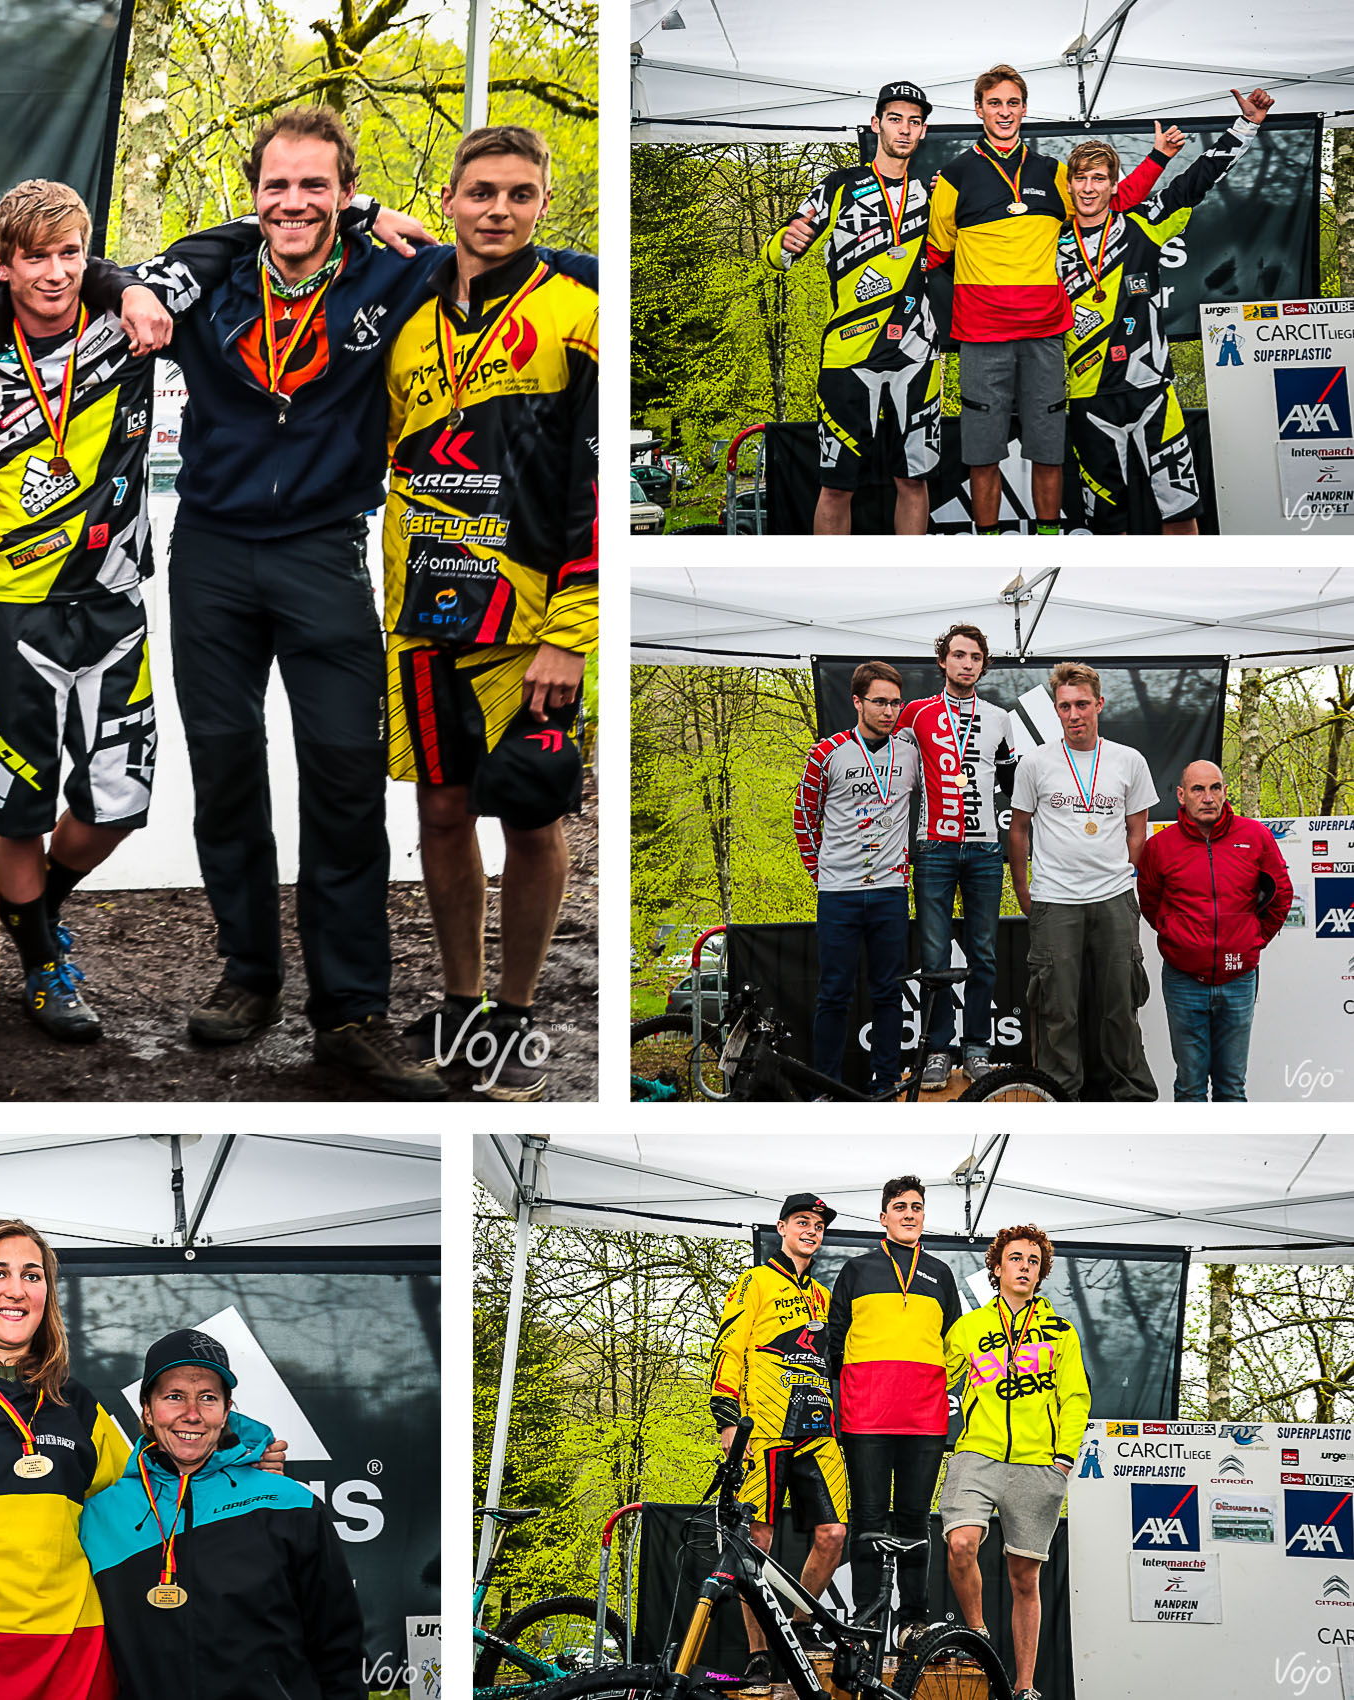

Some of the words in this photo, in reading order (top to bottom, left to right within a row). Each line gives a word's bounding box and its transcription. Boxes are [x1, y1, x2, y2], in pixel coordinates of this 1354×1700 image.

[889, 85, 922, 100] YETI
[854, 277, 890, 297] adidas
[1129, 278, 1147, 289] ice
[1204, 305, 1231, 316] urge
[1308, 301, 1354, 315] NOTUBE
[1074, 311, 1100, 335] adidas
[1256, 323, 1329, 342] CARCIT
[1253, 347, 1332, 363] SUPERPLASTIC
[153, 389, 187, 398] CITR
[1279, 403, 1340, 432] AXA
[1291, 447, 1354, 460] Intermarch
[407, 473, 503, 489] KROSS
[20, 472, 74, 508] adidas
[1306, 490, 1354, 501] NANDRIN
[408, 514, 508, 541] Bicyclic
[429, 555, 500, 573] omnimut
[1308, 820, 1354, 832] SUPERPLA
[1333, 863, 1354, 873] NOT
[1316, 907, 1354, 932] AX
[978, 1328, 1044, 1353] eleen
[1166, 1424, 1215, 1435] NOTUBES
[1218, 1425, 1263, 1439] FOX
[1277, 1426, 1352, 1441] SUPERPLASTIC
[1117, 1443, 1184, 1458] CARCIT
[1183, 1450, 1211, 1460] LIEGE
[1321, 1452, 1347, 1462] urge
[1113, 1465, 1186, 1478] SUPERPLASTIC
[1305, 1474, 1354, 1487] NOTUBES
[213, 1494, 279, 1514] LAPIERRE
[1133, 1517, 1189, 1545] AXA
[1286, 1524, 1344, 1552] AXA
[1154, 1599, 1199, 1610] NANDRIN
[1157, 1611, 1194, 1621] OUFFET
[754, 1573, 823, 1692] KROSS
[1318, 1627, 1354, 1645] CAR
